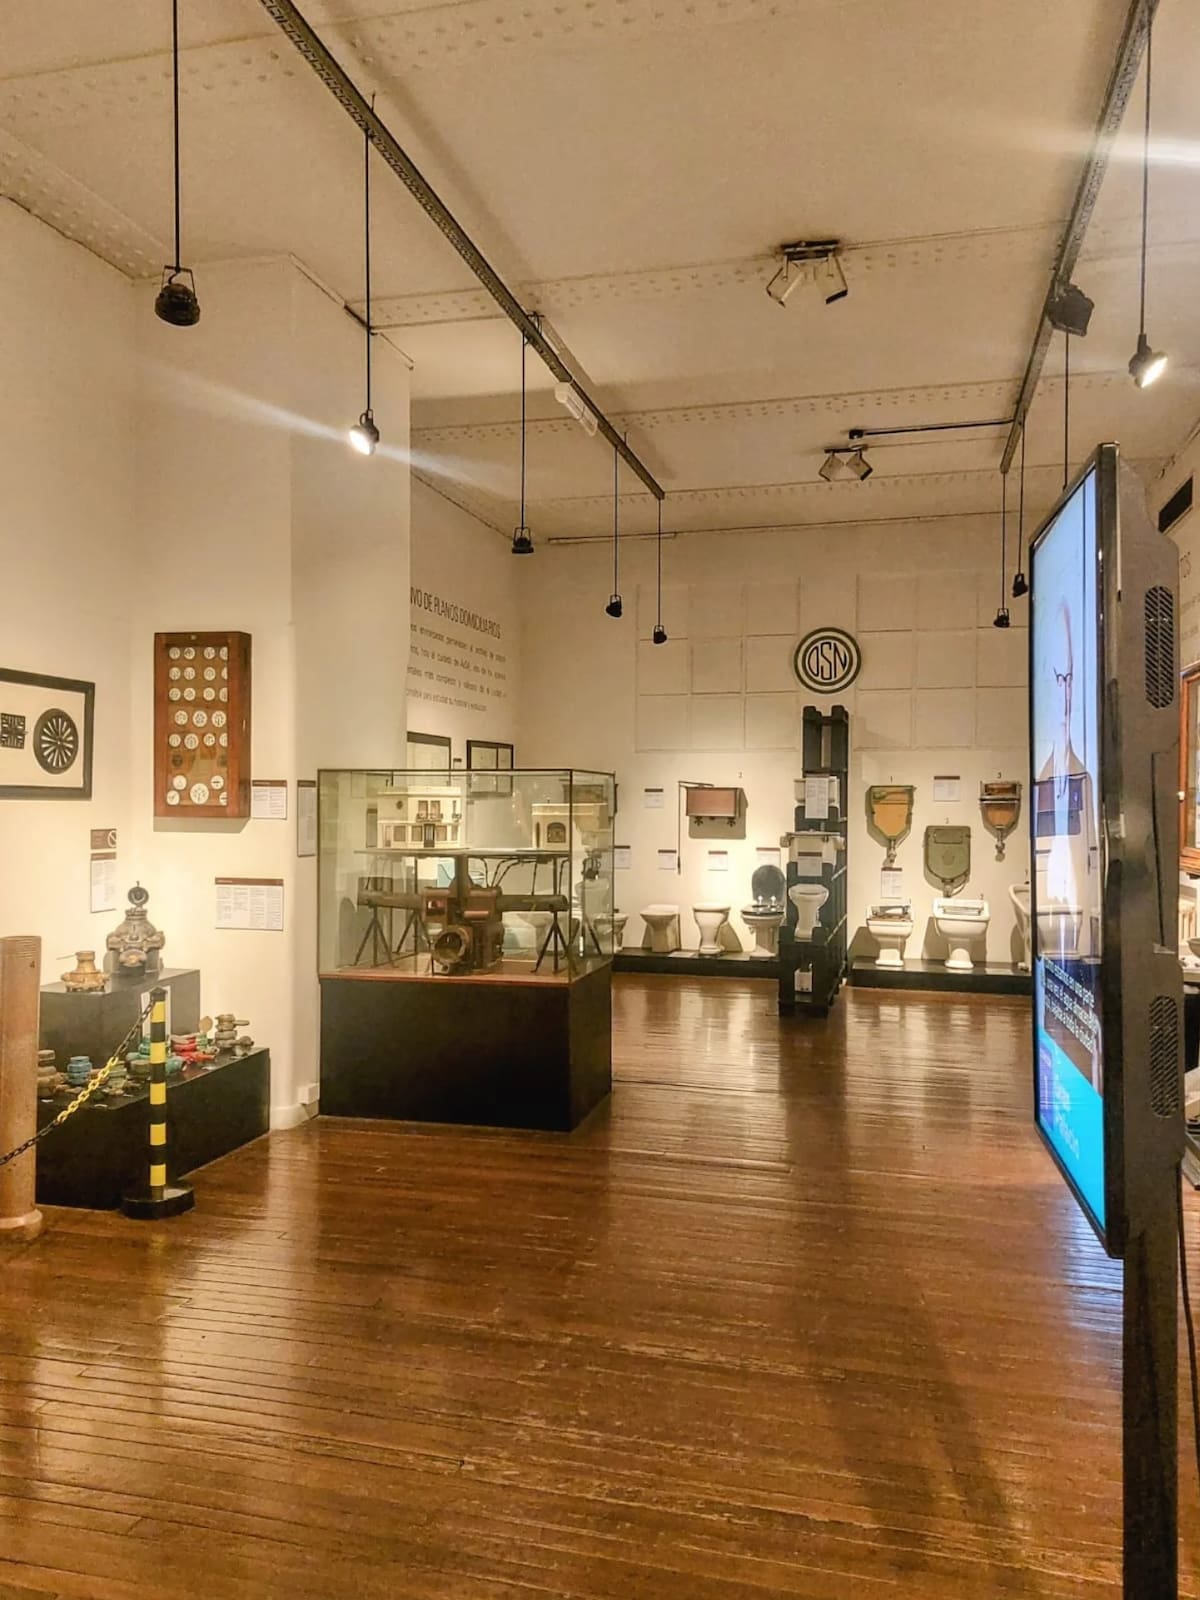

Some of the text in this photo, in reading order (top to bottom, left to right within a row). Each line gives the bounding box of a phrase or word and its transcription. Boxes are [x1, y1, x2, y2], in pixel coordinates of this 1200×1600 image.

[423, 591, 433, 613] DE
[434, 595, 459, 624] PLANOS
[807, 640, 848, 681] OSN
